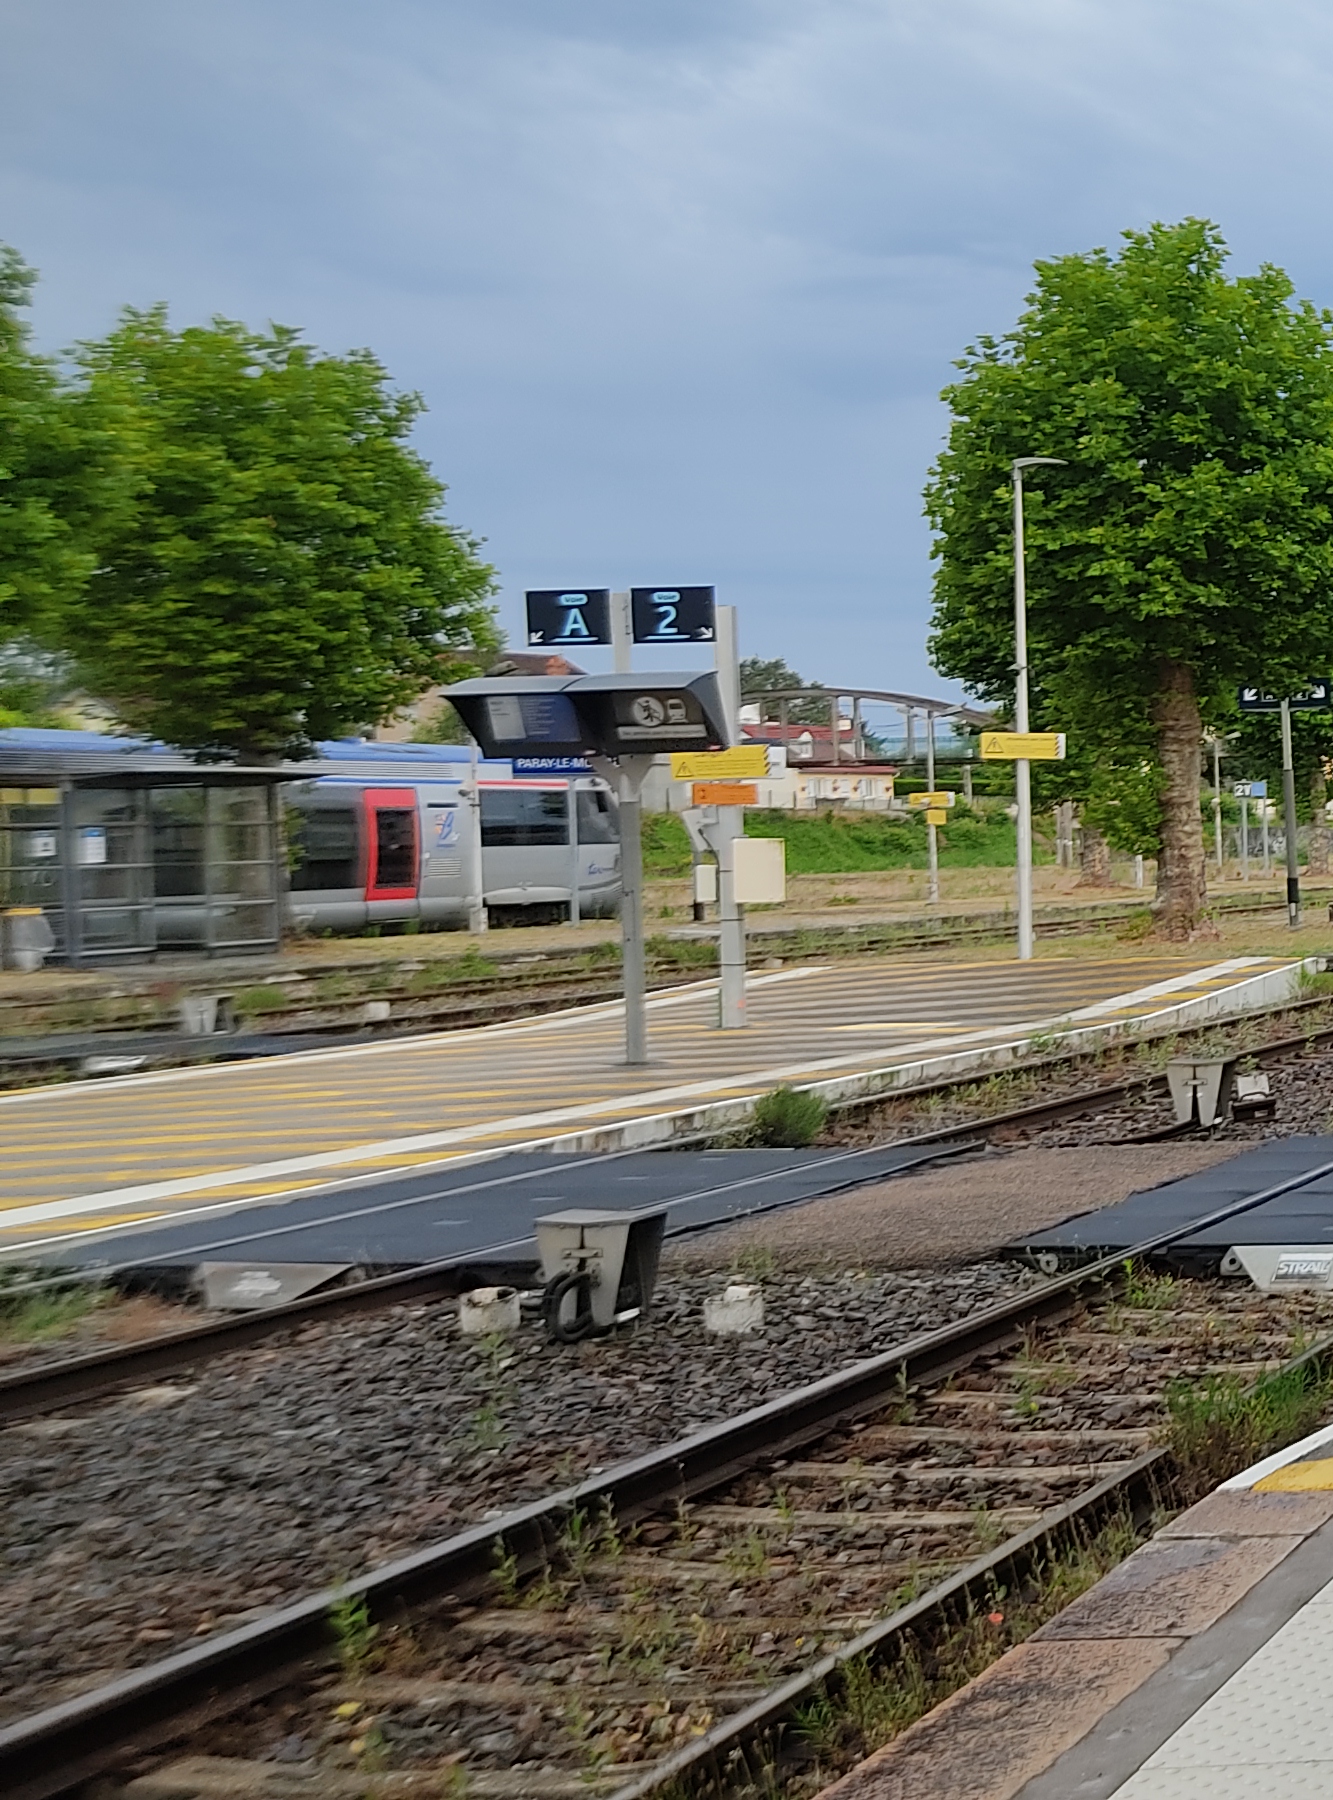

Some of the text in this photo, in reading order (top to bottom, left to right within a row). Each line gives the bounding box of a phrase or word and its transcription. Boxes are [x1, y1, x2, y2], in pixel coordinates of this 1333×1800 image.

[563, 608, 590, 636] A
[656, 605, 679, 634] 2
[1277, 1261, 1331, 1275] STRAIL
